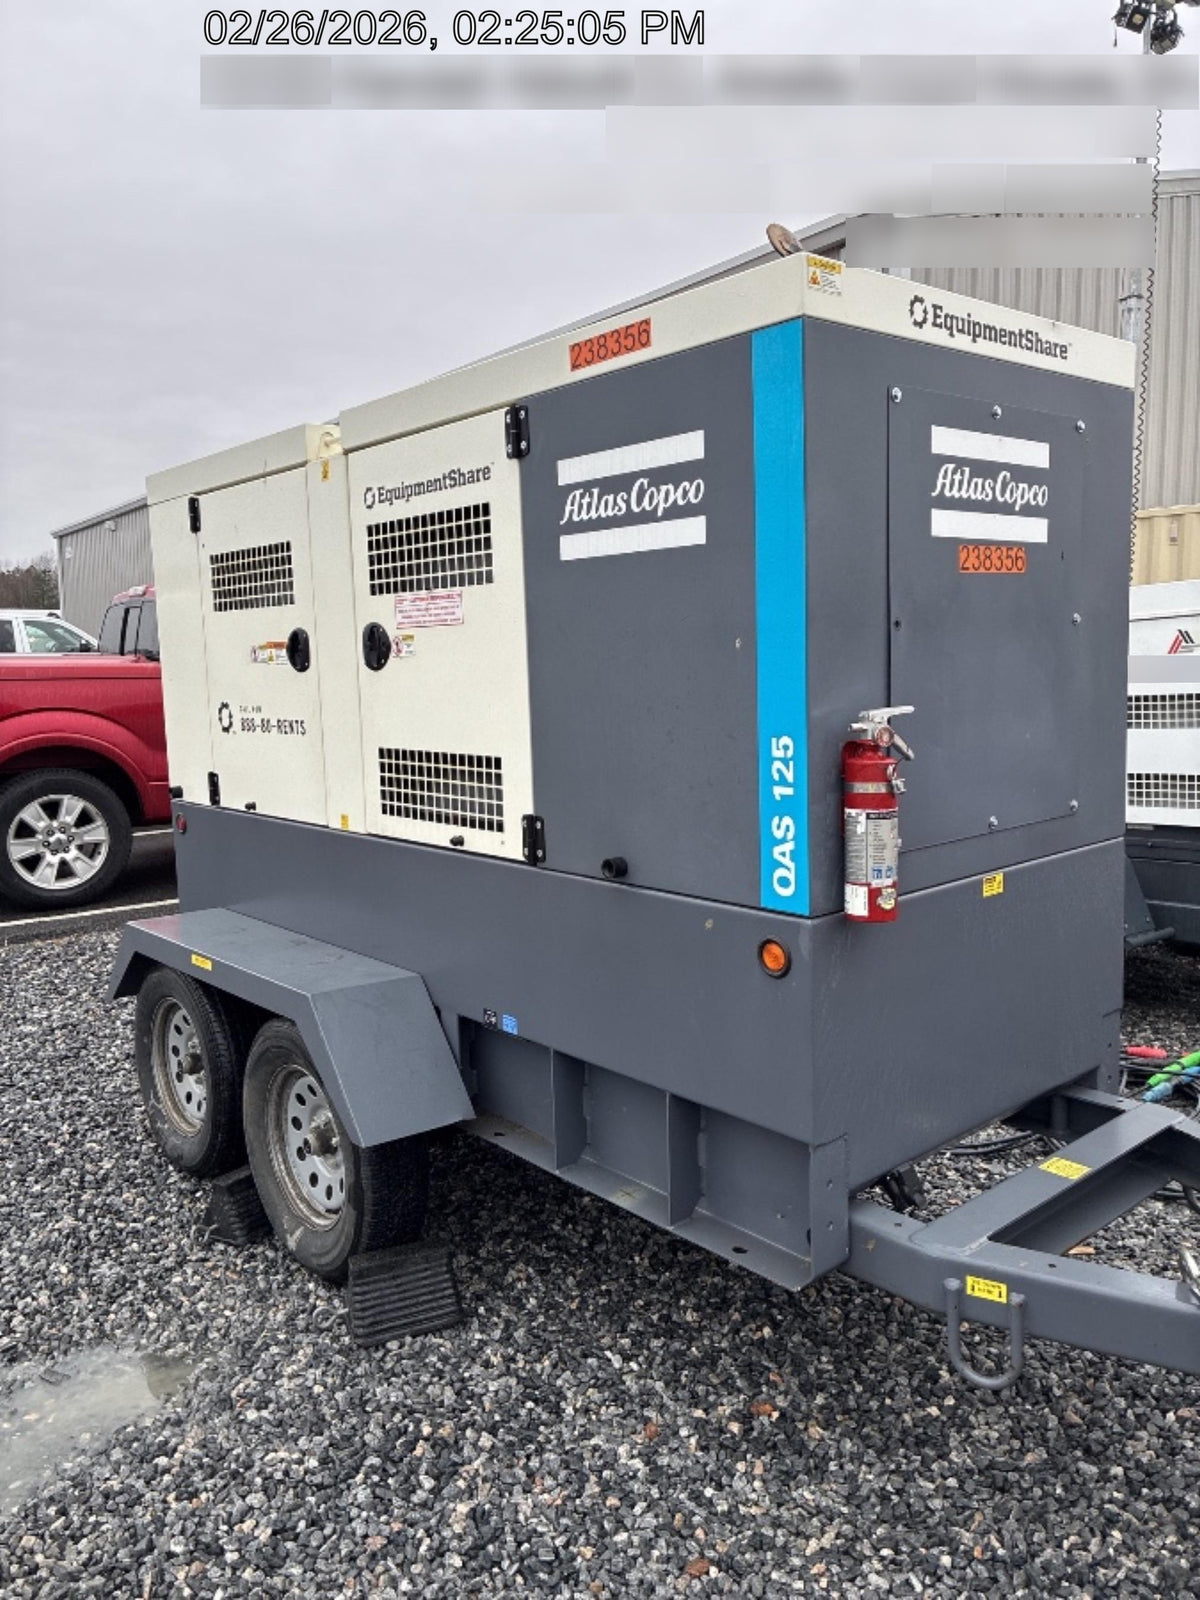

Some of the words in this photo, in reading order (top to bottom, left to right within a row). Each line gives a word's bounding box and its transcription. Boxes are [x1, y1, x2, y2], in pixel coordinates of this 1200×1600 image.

[570, 319, 650, 370] 238356
[931, 303, 1068, 360] EquipmentShare
[377, 465, 491, 506] EquipmentShare
[560, 487, 628, 526] Atlas
[630, 477, 705, 517] Copco
[931, 463, 994, 501] Atlas
[995, 470, 1049, 511] Copco
[960, 545, 1025, 571] 238356
[771, 735, 795, 801] 125
[771, 815, 796, 897] QAS
